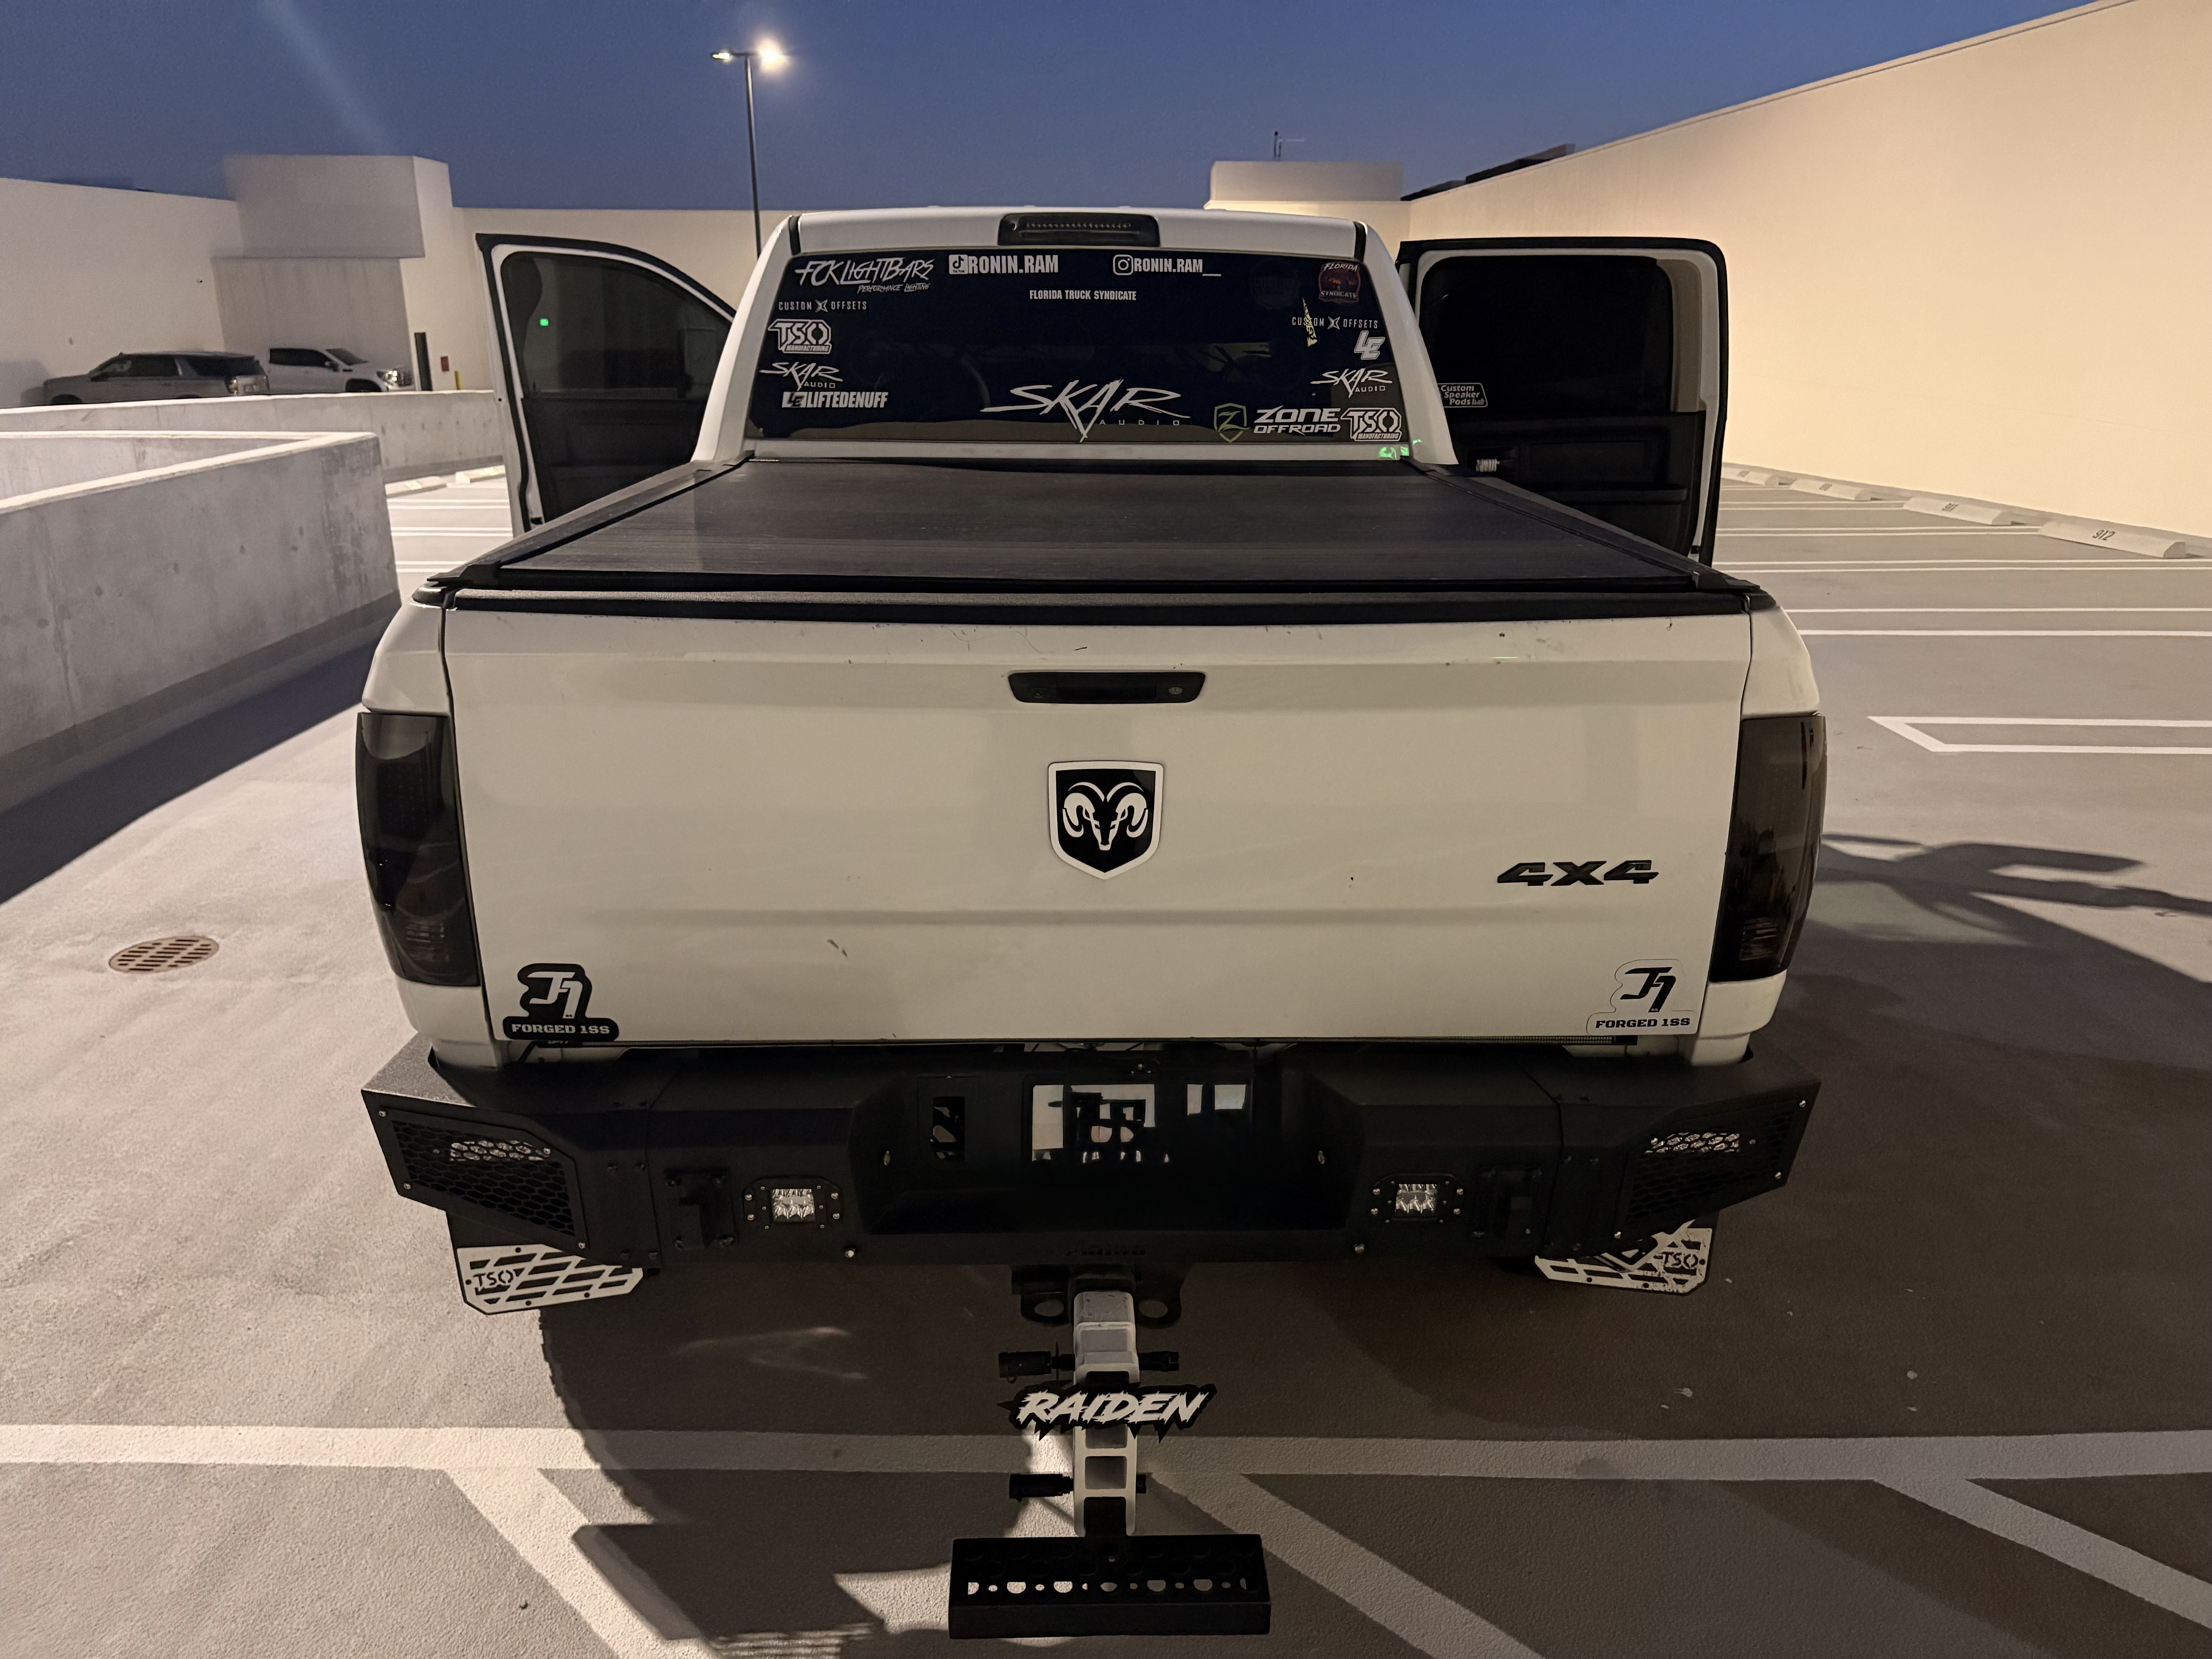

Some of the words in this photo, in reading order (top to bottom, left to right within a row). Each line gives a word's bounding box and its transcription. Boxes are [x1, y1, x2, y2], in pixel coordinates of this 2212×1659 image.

[969, 255, 1058, 274] RONIN.RAM
[1323, 263, 1358, 272] FLORIDA
[857, 285, 903, 294] PERFORMANCE
[904, 283, 931, 292] LIGHTING
[1029, 290, 1063, 299] FLORIDA
[1065, 290, 1091, 299] TRUCK
[1094, 290, 1137, 300] SYNDICATE
[1321, 290, 1357, 299] SYNDICATE
[778, 301, 812, 310] CUSTOM
[831, 301, 867, 310] OFFSETS
[1292, 317, 1324, 326] CUSOM
[1343, 319, 1378, 329] OFFSETS
[759, 362, 843, 391] SKAR
[1310, 368, 1393, 398] SKAR
[806, 392, 888, 408] LIFTEDENUFF
[1444, 391, 1480, 399] Speaker
[980, 380, 1191, 442] SKAR
[1254, 405, 1341, 423] ZONE
[1254, 424, 1341, 435] OFFROAD
[2092, 529, 2116, 541] 912
[1595, 1018, 1657, 1028] FORGED
[1661, 1018, 1691, 1026] 1SS
[512, 1024, 575, 1033] FORGED
[580, 1025, 610, 1034] 1SS
[1016, 1389, 1209, 1424] RAIDEN
